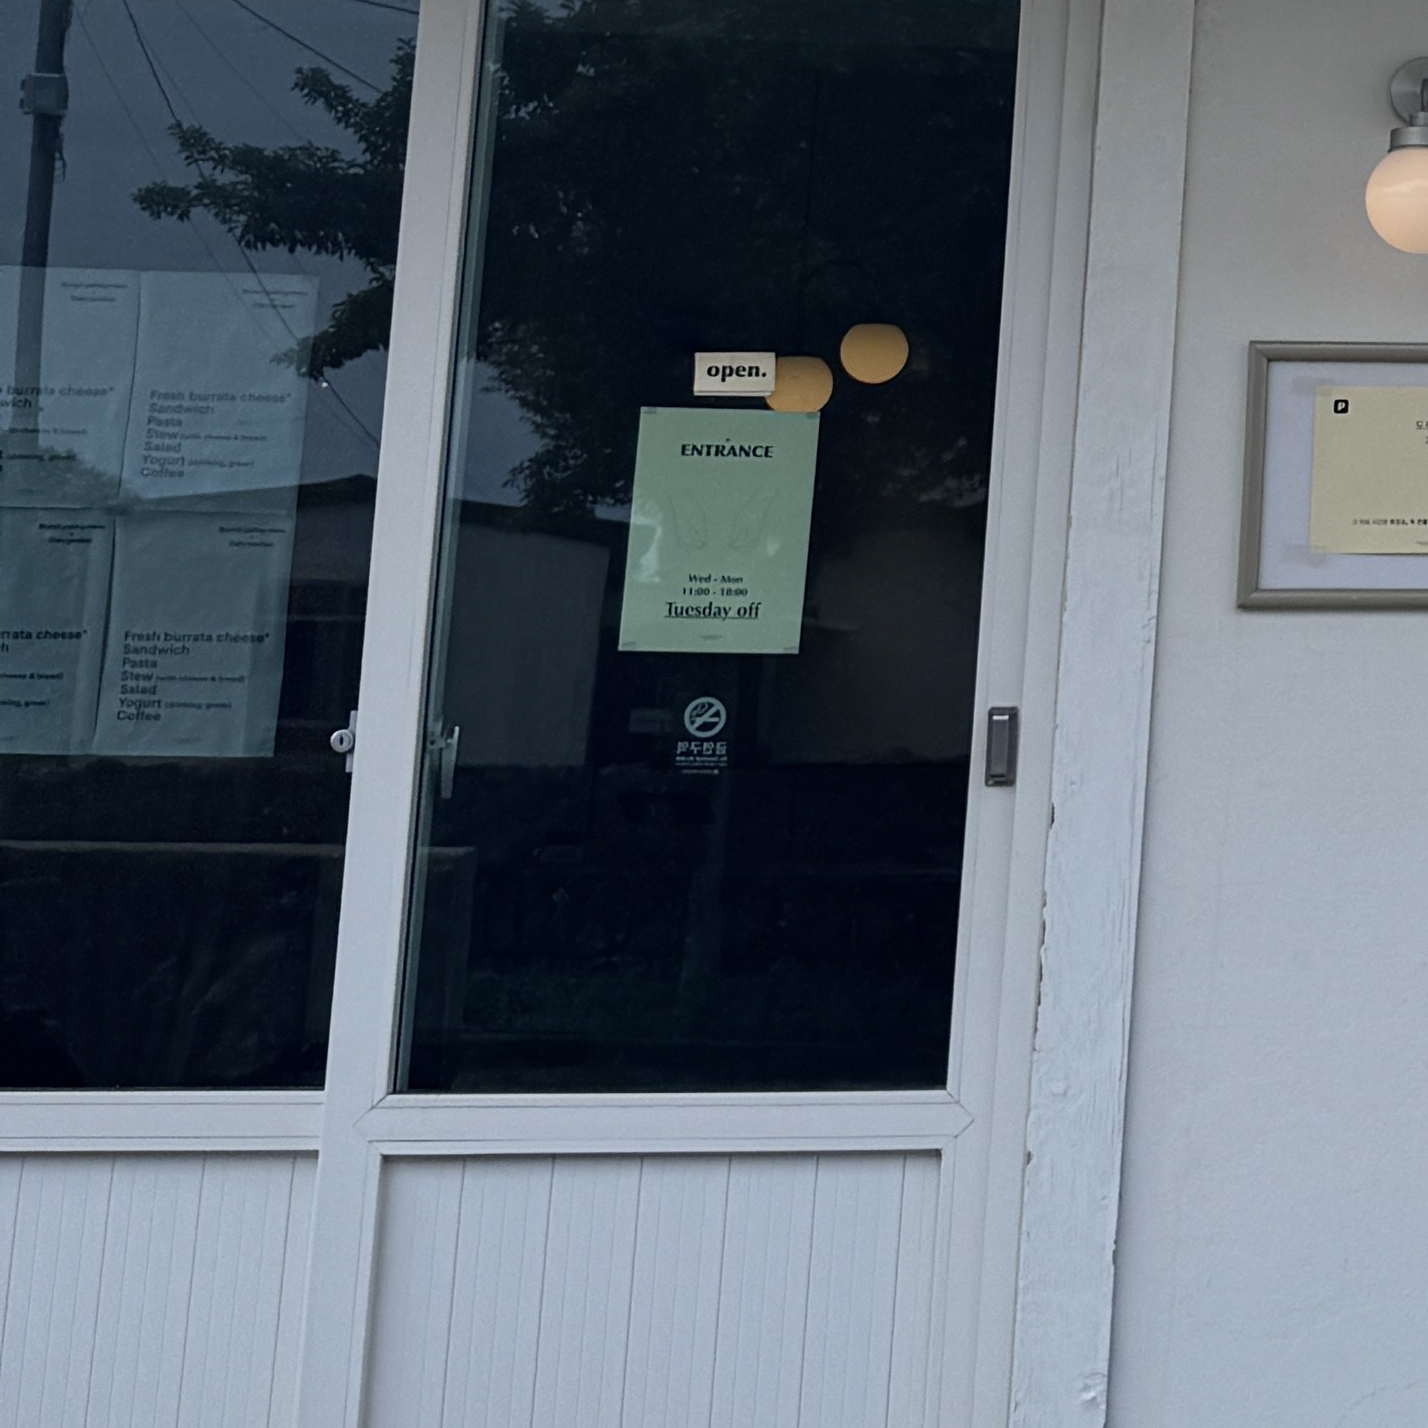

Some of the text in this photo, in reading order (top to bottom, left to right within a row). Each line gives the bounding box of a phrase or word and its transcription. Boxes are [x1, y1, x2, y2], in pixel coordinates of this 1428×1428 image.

[707, 365, 767, 383] open.
[150, 390, 185, 401] Fresh
[190, 392, 237, 402] burrata
[149, 403, 215, 415] Sandwich
[147, 415, 183, 427] Pasta
[147, 428, 179, 439] Stew
[144, 442, 181, 453] Salad
[681, 444, 775, 458] ENTRANCE
[143, 454, 186, 470] Yogurt
[140, 468, 184, 478] Coffee
[688, 574, 712, 583] Wed
[721, 575, 743, 584] Mon
[683, 587, 710, 596] 11:00
[665, 601, 762, 621] Tuesday off
[125, 631, 160, 641] Fresh
[164, 632, 213, 642] burrata
[124, 644, 190, 655] Sandwich
[123, 657, 158, 668] Pasta
[121, 670, 154, 681] Stew
[120, 684, 157, 695] Salad
[119, 697, 162, 711] Yogurt
[117, 711, 161, 720] Coffee
